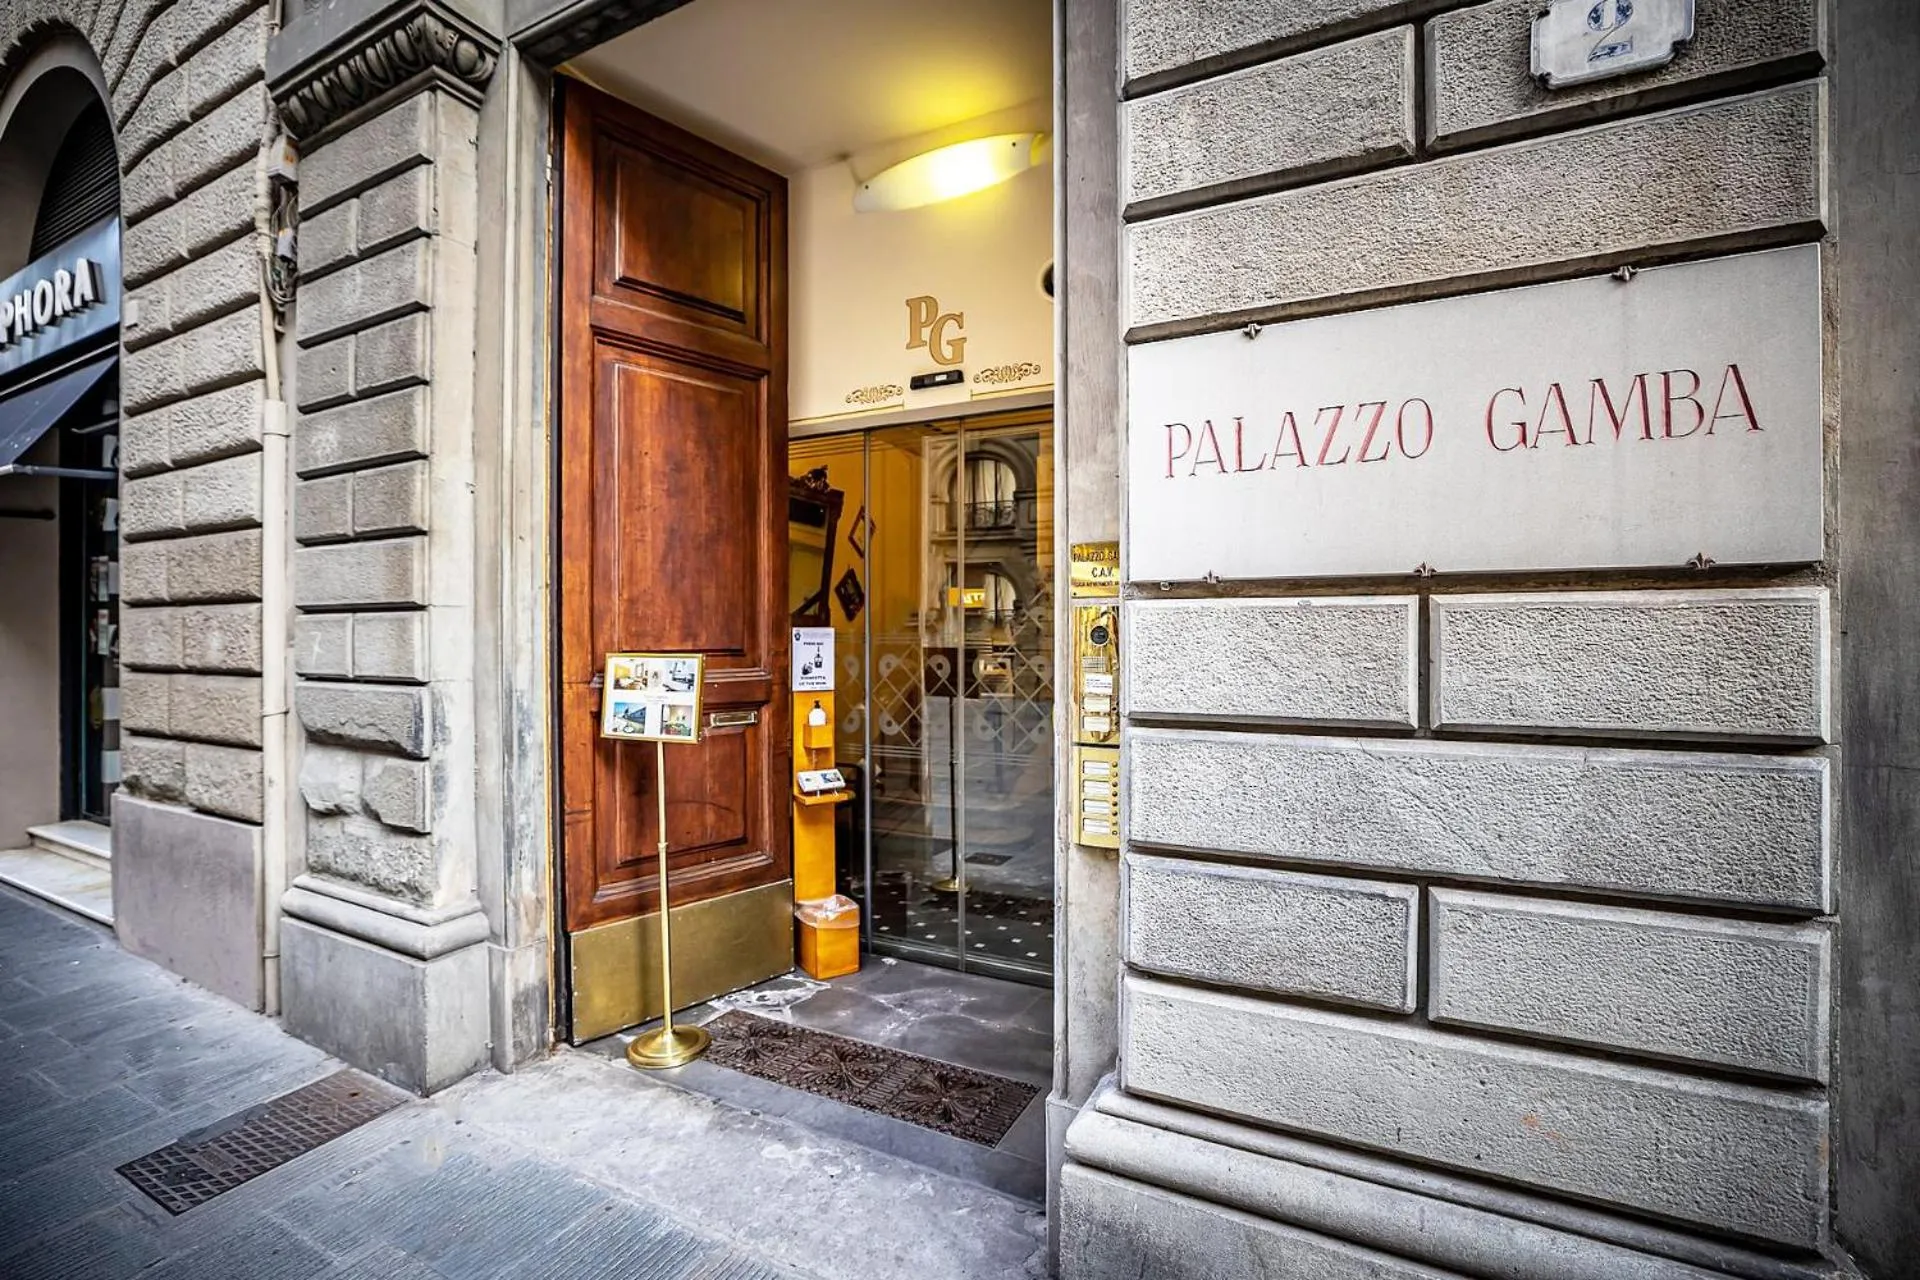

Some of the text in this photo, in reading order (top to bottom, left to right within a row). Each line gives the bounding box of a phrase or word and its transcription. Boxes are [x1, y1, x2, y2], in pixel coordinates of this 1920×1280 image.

[1587, 0, 1634, 63] 2
[0, 258, 96, 343] PHORA
[1164, 363, 1765, 480] PALAZZO GAMBA
